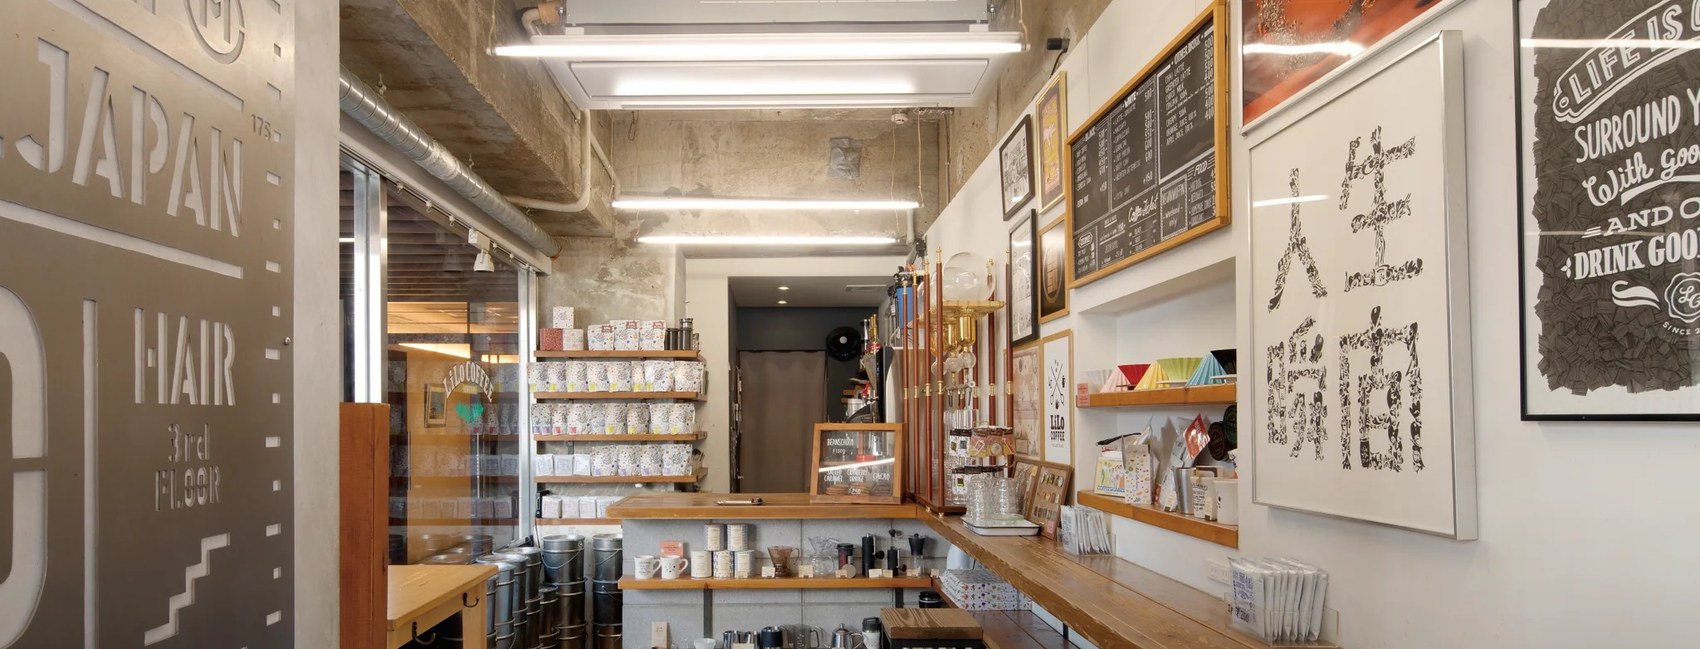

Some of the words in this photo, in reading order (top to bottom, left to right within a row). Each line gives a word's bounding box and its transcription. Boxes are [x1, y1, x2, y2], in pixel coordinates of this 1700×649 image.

[1569, 29, 1641, 104] LIFE
[1647, 4, 1683, 52] IS
[251, 113, 271, 141] 175
[1574, 94, 1681, 164] SURROUND
[1582, 152, 1654, 206] With
[1603, 206, 1673, 236] AND
[1574, 240, 1645, 280] DRINK
[1648, 228, 1700, 266] GOO
[1662, 321, 1691, 335] SINCE
[134, 307, 236, 407] HAIR
[168, 422, 211, 463] 3rd
[155, 465, 222, 512] FLOOR
